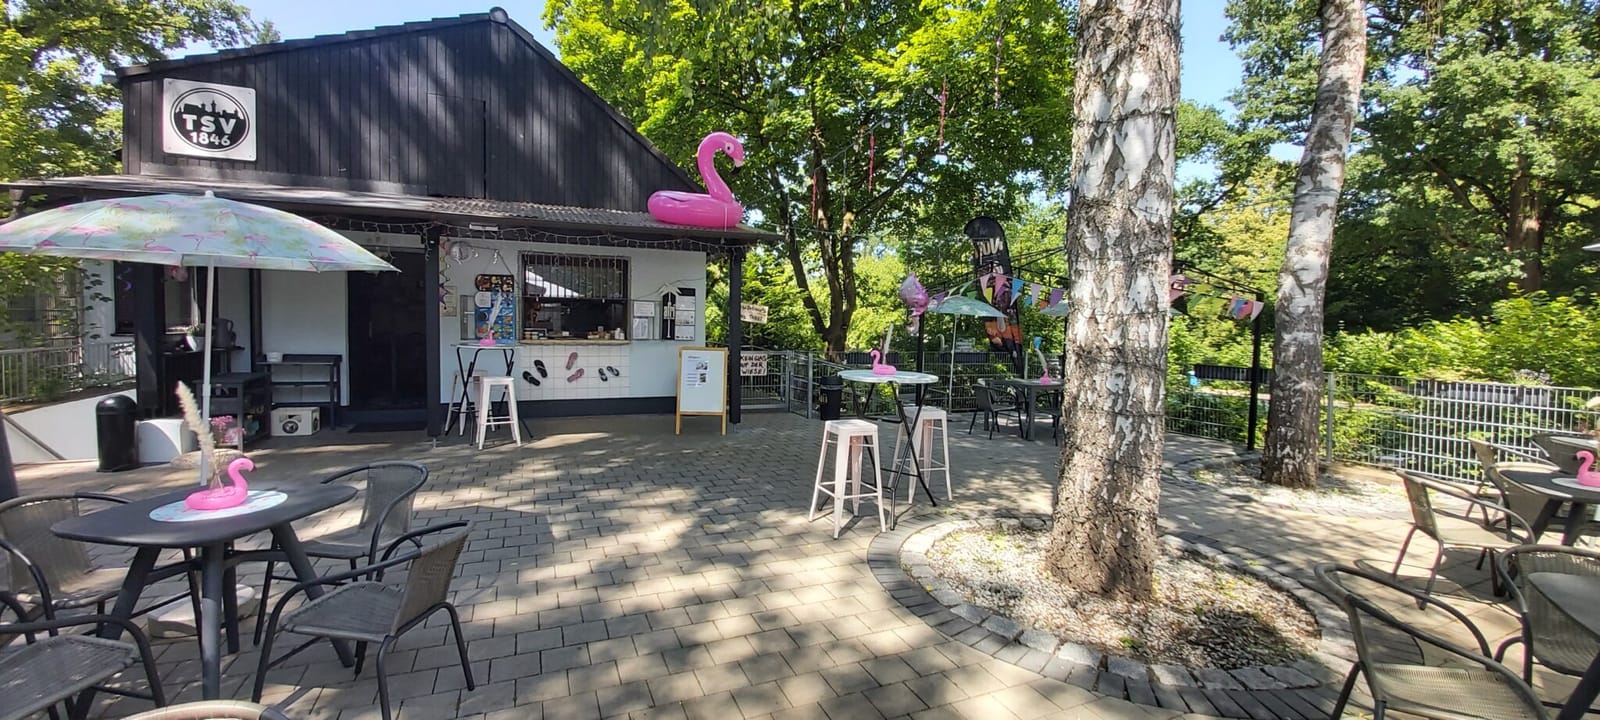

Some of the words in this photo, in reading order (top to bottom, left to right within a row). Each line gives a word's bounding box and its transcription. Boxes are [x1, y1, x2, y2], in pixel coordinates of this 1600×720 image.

[182, 114, 236, 134] TSV
[189, 132, 231, 145] 1846
[750, 361, 764, 369] DER
